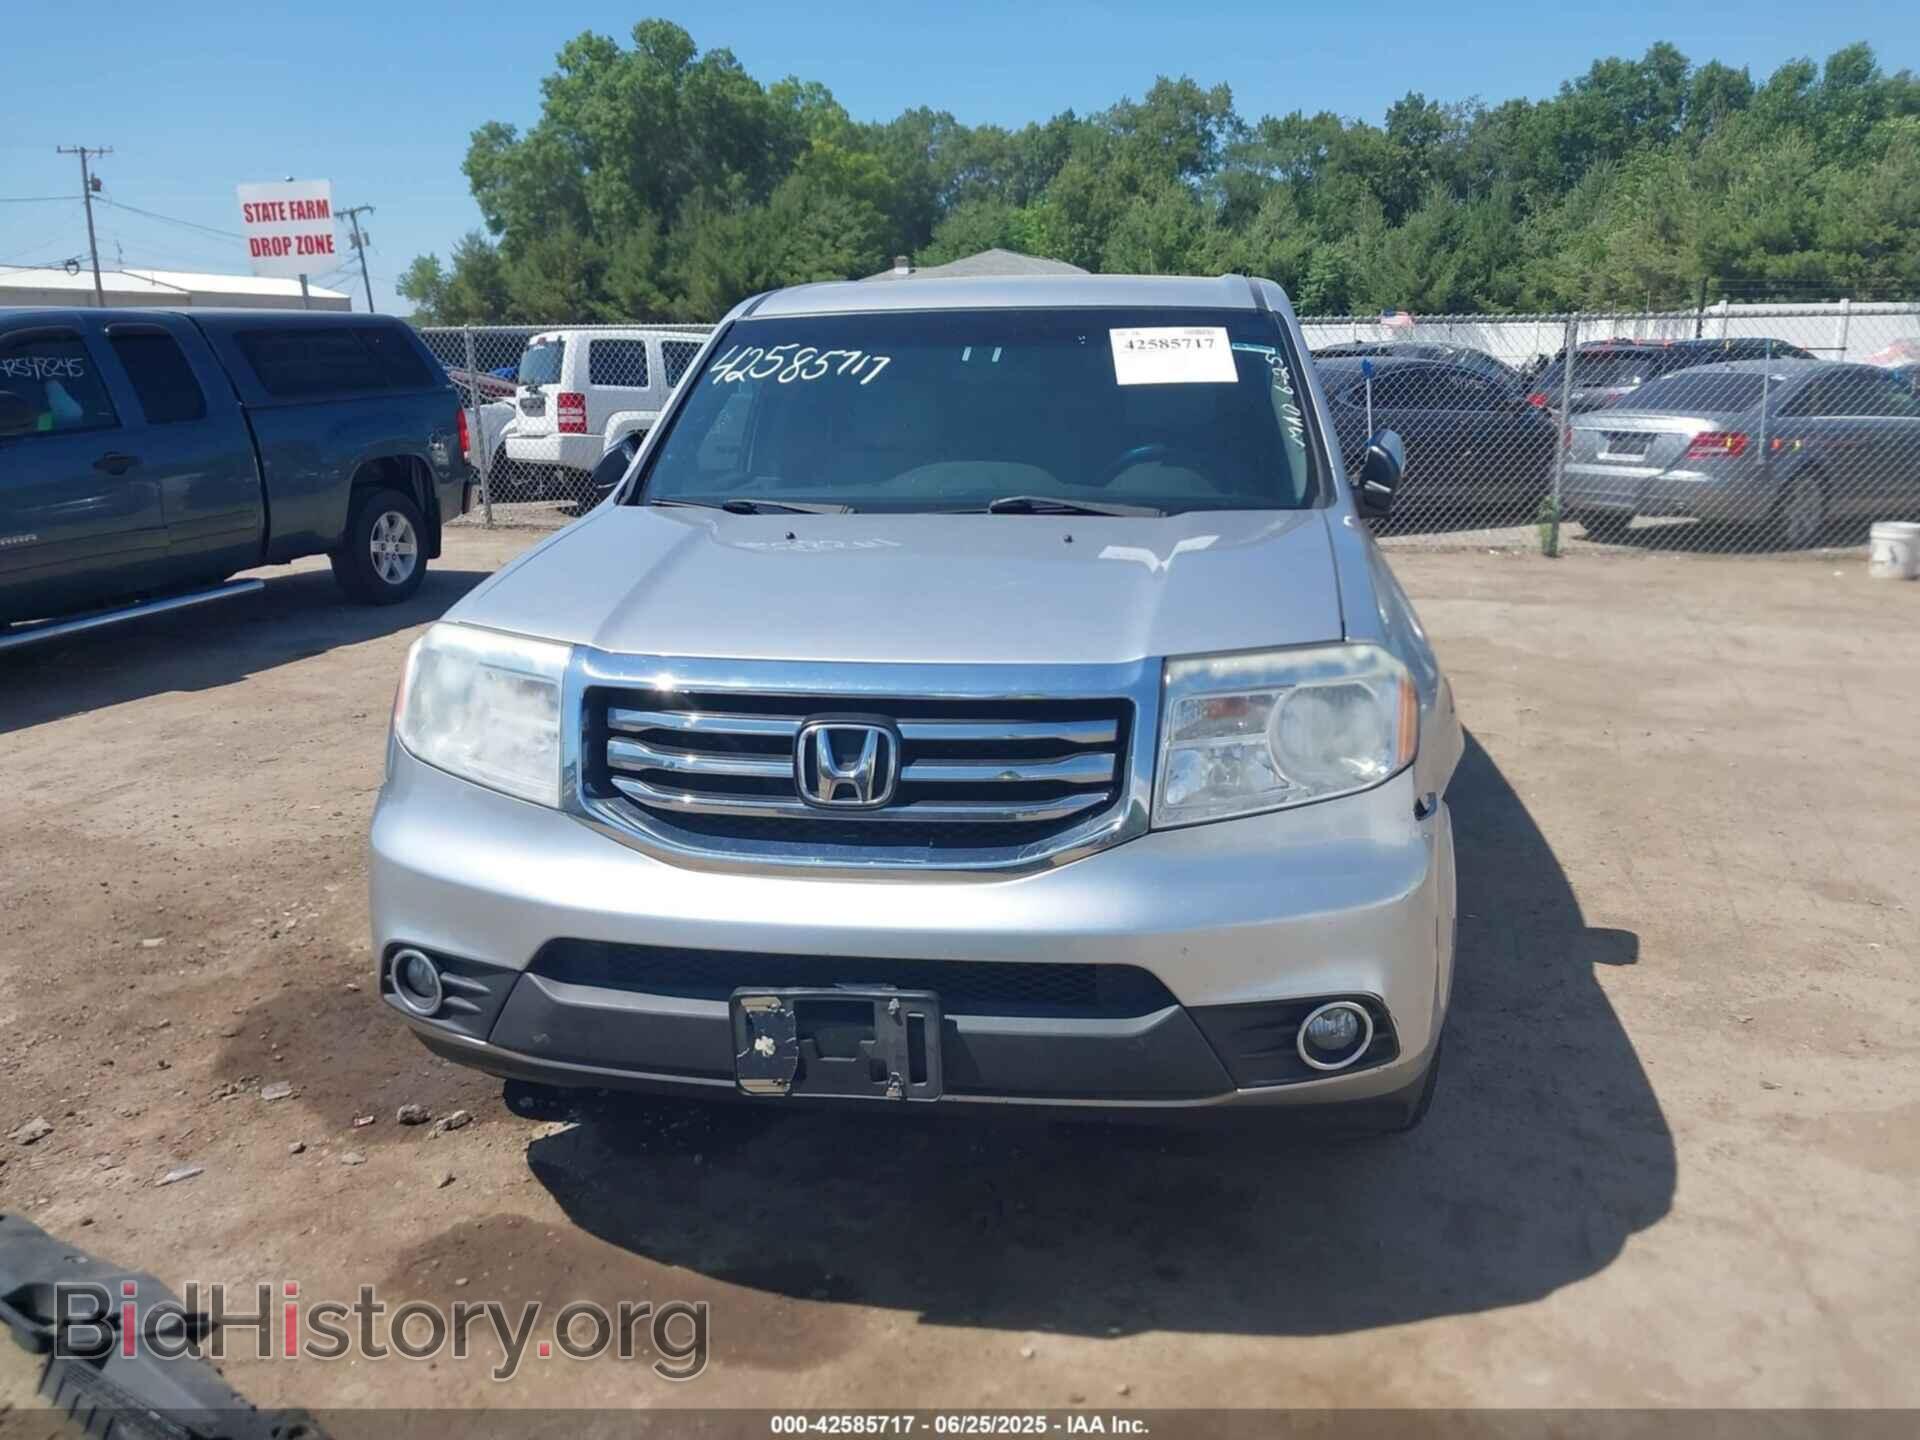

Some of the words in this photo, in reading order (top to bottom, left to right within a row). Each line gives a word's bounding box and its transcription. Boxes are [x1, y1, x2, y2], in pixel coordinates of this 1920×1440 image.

[243, 201, 287, 223] STATE
[288, 199, 331, 220] FARM
[249, 236, 292, 257] DROP
[294, 234, 335, 255] ZONE
[1124, 338, 1215, 350] 42585717
[710, 343, 891, 385] 42585717
